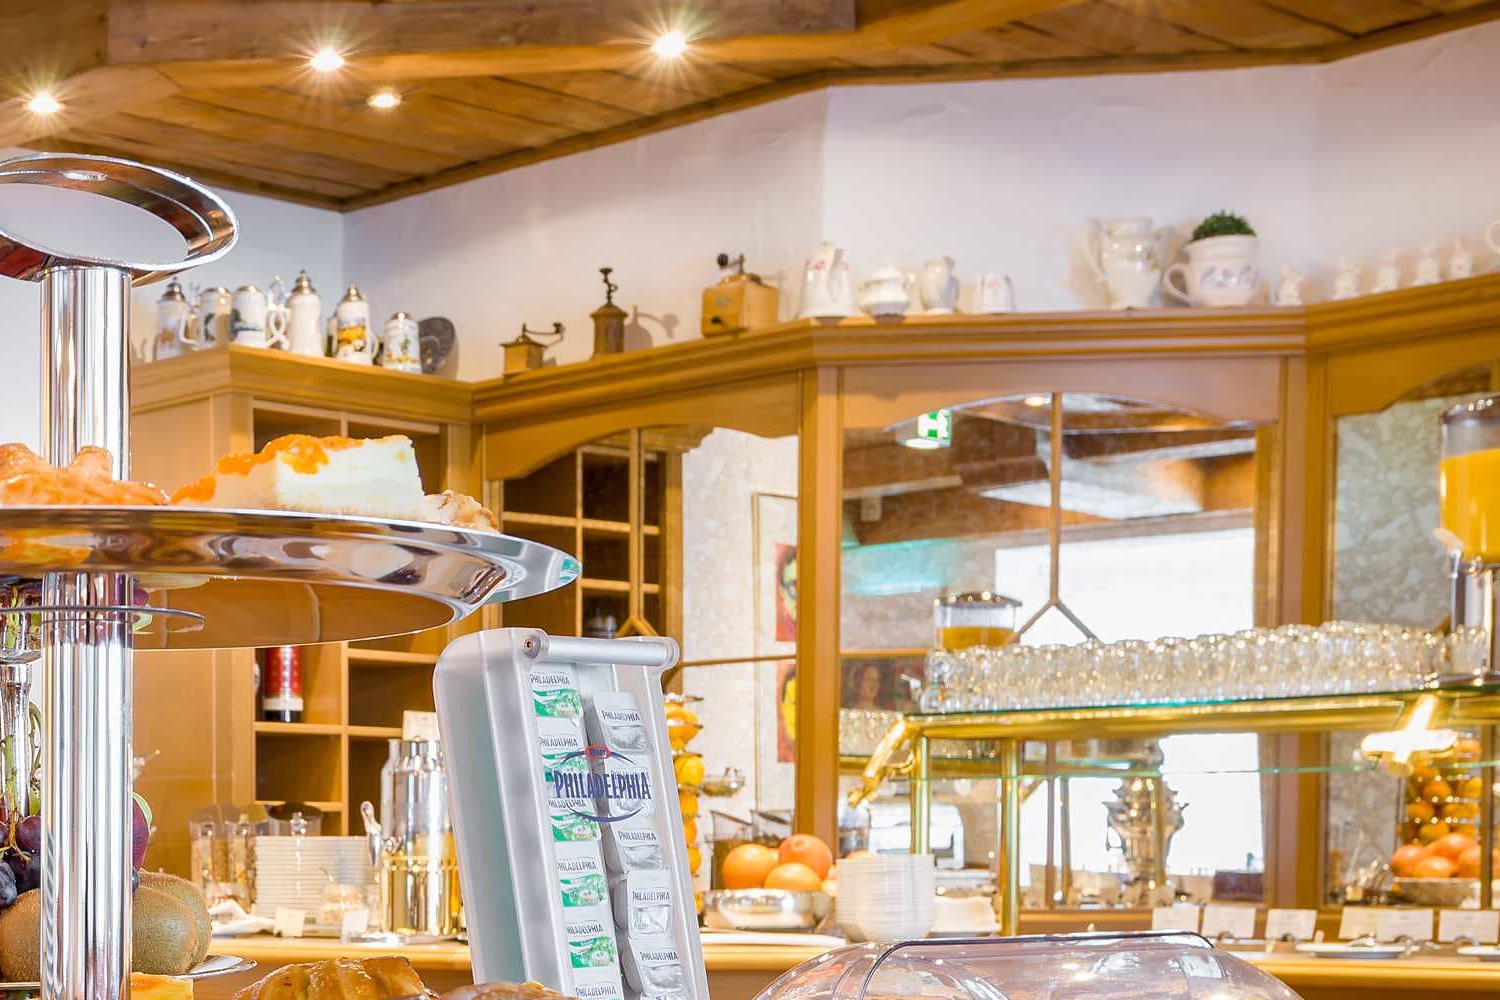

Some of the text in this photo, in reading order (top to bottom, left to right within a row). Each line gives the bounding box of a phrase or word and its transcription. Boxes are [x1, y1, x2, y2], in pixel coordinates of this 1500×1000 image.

[530, 673, 571, 686] PHILADELPHIA
[601, 710, 642, 722] PHILADELPHIA
[539, 736, 579, 748] PHILADELPHIA
[553, 769, 651, 800] PHILADELPHIA
[618, 830, 657, 841] PHILADELPHIA
[557, 861, 597, 872] PHILADELPHIA
[632, 890, 670, 902] PHILADELPHIA
[639, 951, 678, 962] PHILADELPHIA
[575, 985, 617, 997] PHILADELPHIA
